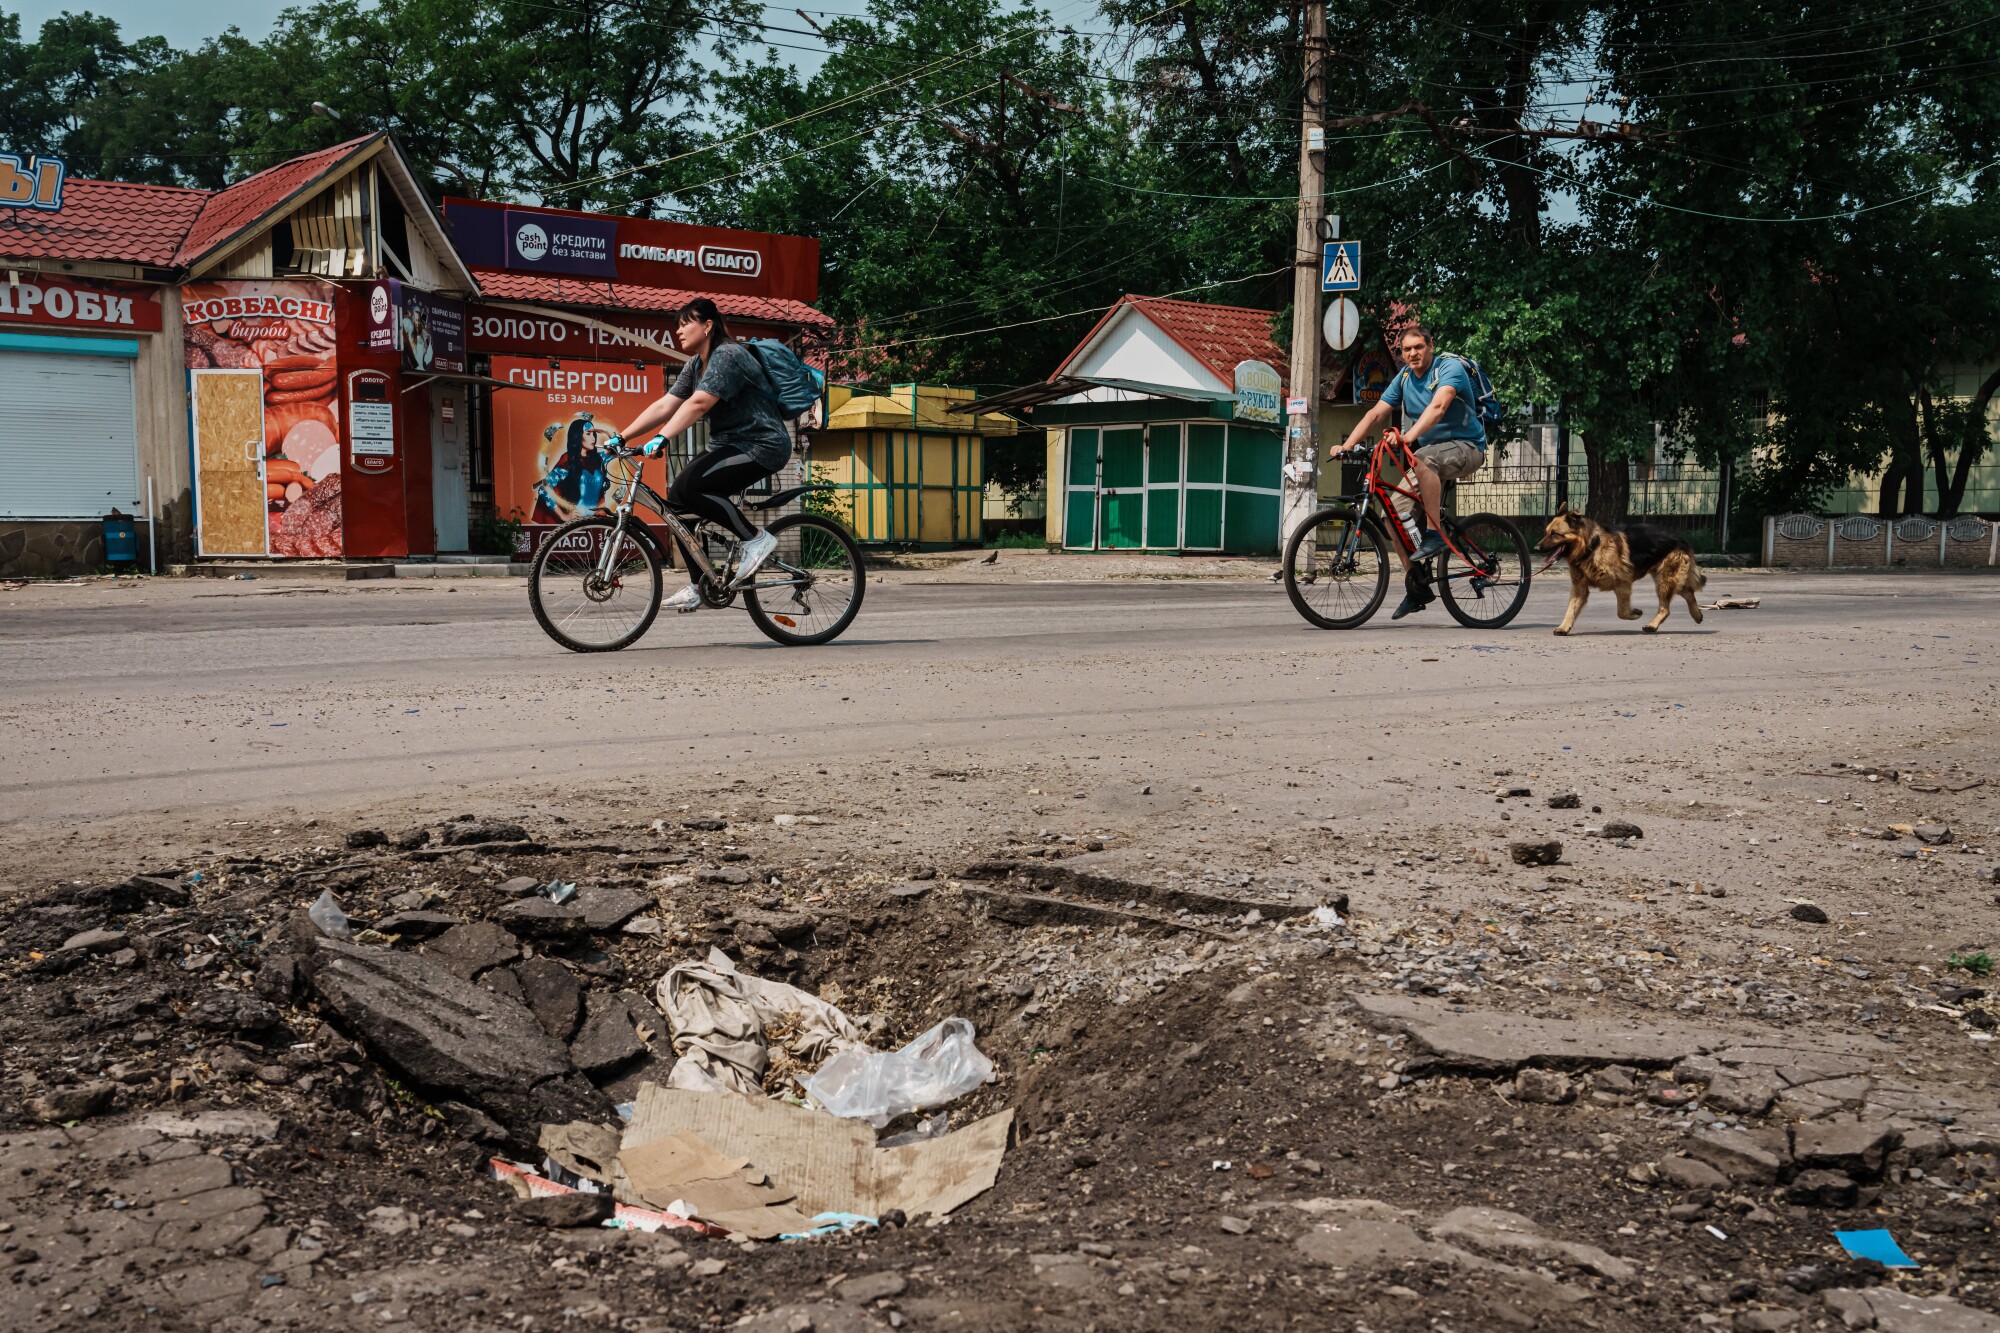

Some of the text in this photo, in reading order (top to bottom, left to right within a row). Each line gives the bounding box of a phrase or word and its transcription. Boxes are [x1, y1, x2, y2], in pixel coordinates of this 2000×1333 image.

[518, 231, 541, 242] Cash
[552, 233, 606, 249] КРЕДИТИ
[522, 240, 547, 252] point
[551, 245, 606, 260] без застави
[620, 243, 755, 271] ЛОМБАРД БЛАГО
[184, 297, 332, 322] КОВБАСНІ
[231, 321, 288, 341] вироби
[471, 316, 566, 342] ЗОЛОТО
[547, 393, 614, 405] БЕЗ ЗАСТАВИ
[1239, 389, 1277, 409] ФРУКТЫ
